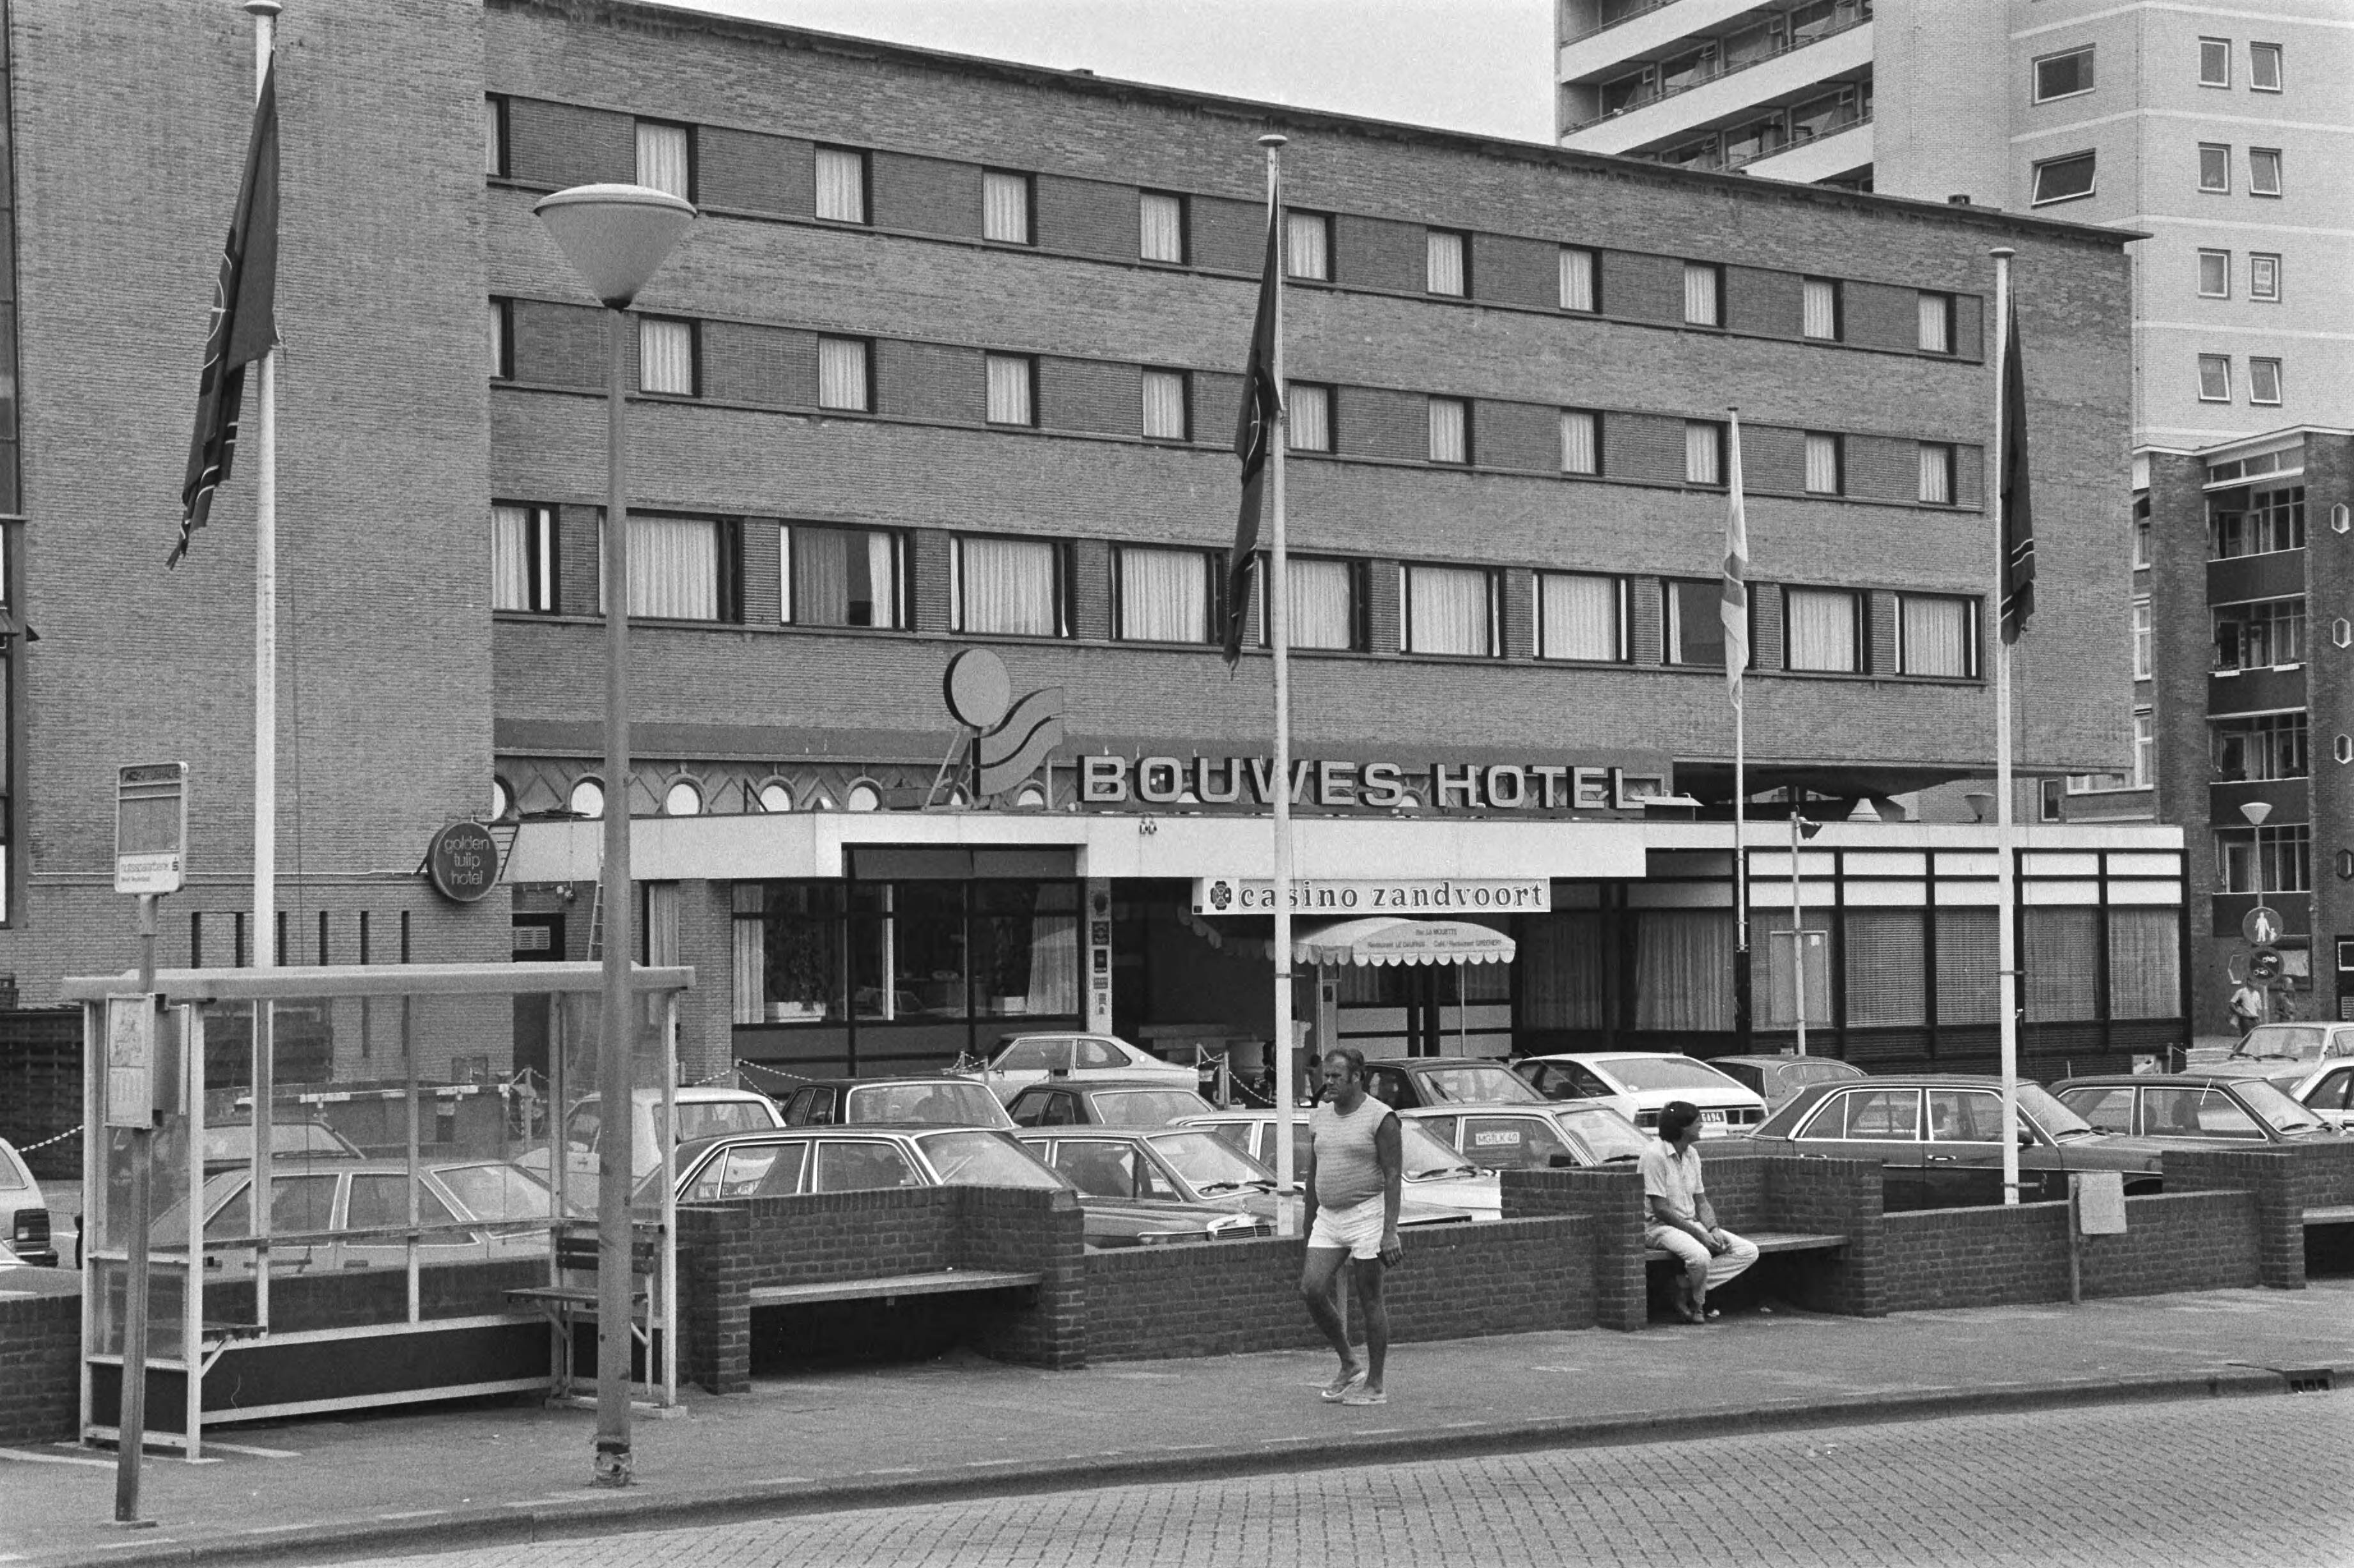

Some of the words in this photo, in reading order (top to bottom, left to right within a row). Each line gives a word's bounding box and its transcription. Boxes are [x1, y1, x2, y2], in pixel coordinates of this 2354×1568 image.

[1078, 755, 1403, 807] BOUWES
[1431, 763, 1645, 810] HOTEL
[444, 835, 490, 854] golden
[453, 852, 480, 870] tulip
[451, 870, 483, 885] hotel
[1240, 881, 1358, 908] casino
[1372, 881, 1543, 907] zandvoort
